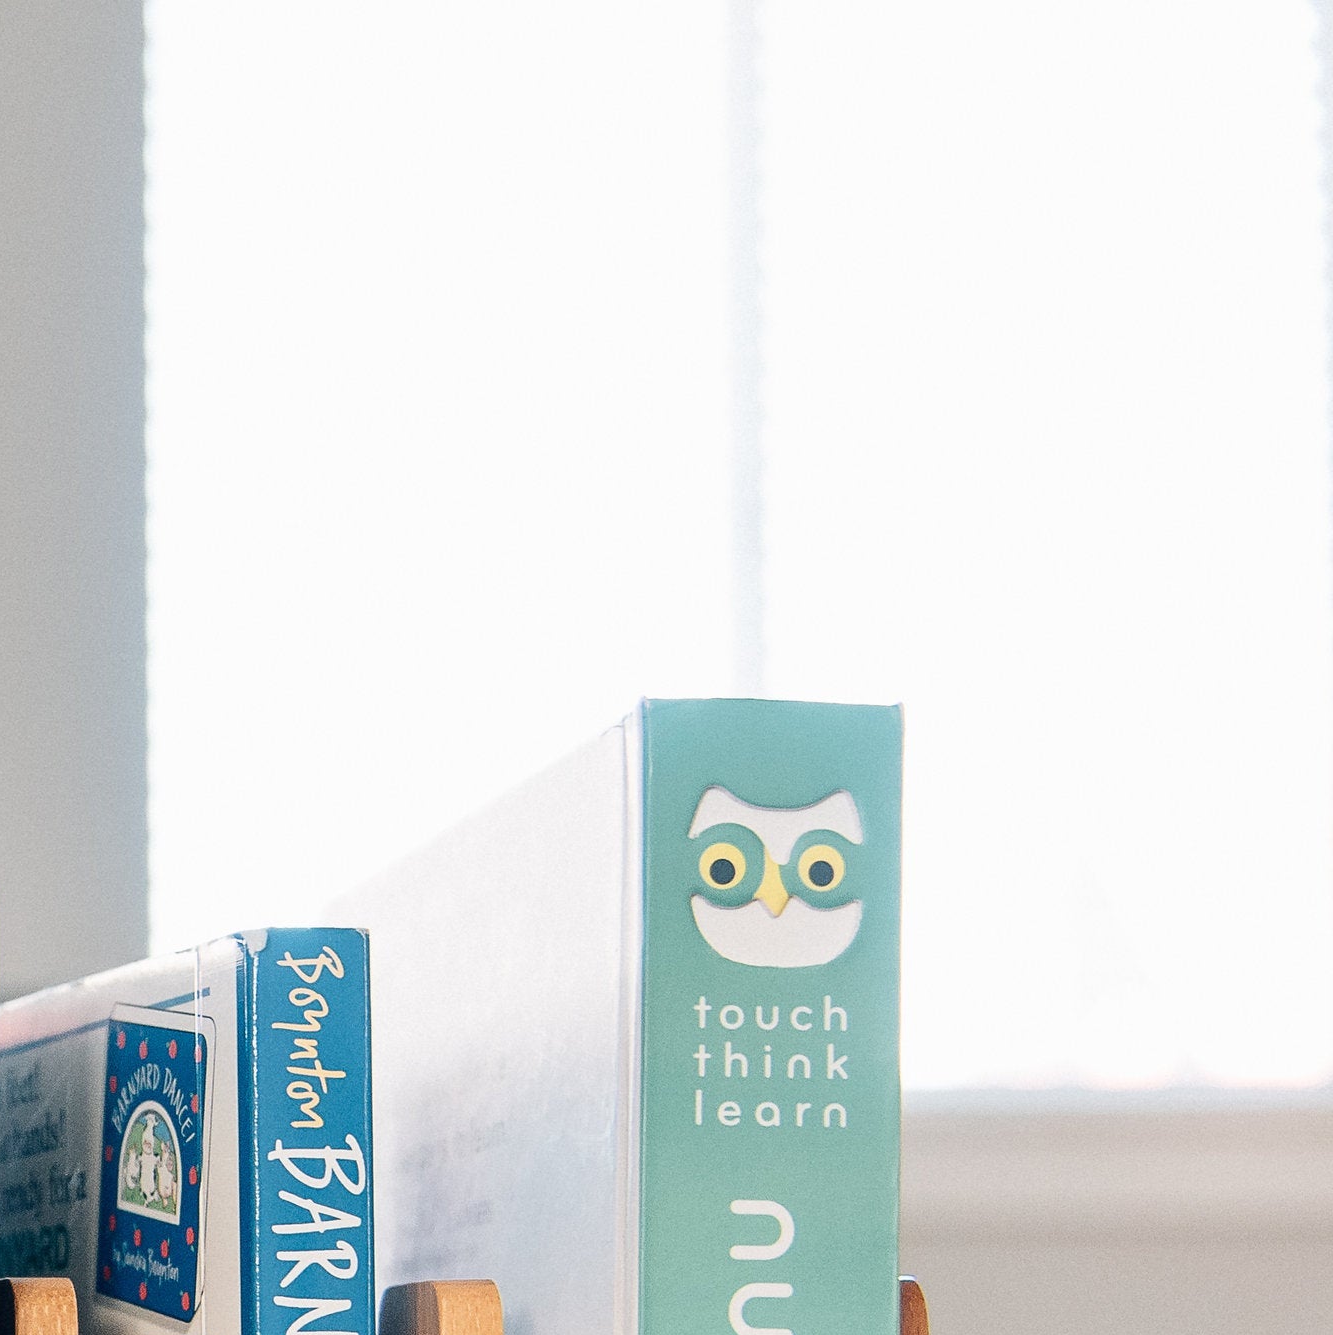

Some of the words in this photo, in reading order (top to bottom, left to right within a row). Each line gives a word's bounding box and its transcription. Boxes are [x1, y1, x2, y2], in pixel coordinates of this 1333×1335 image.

[693, 994, 848, 1032] touch
[271, 946, 347, 1129] Boynton
[693, 1041, 849, 1081] think
[694, 1089, 848, 1127] learn
